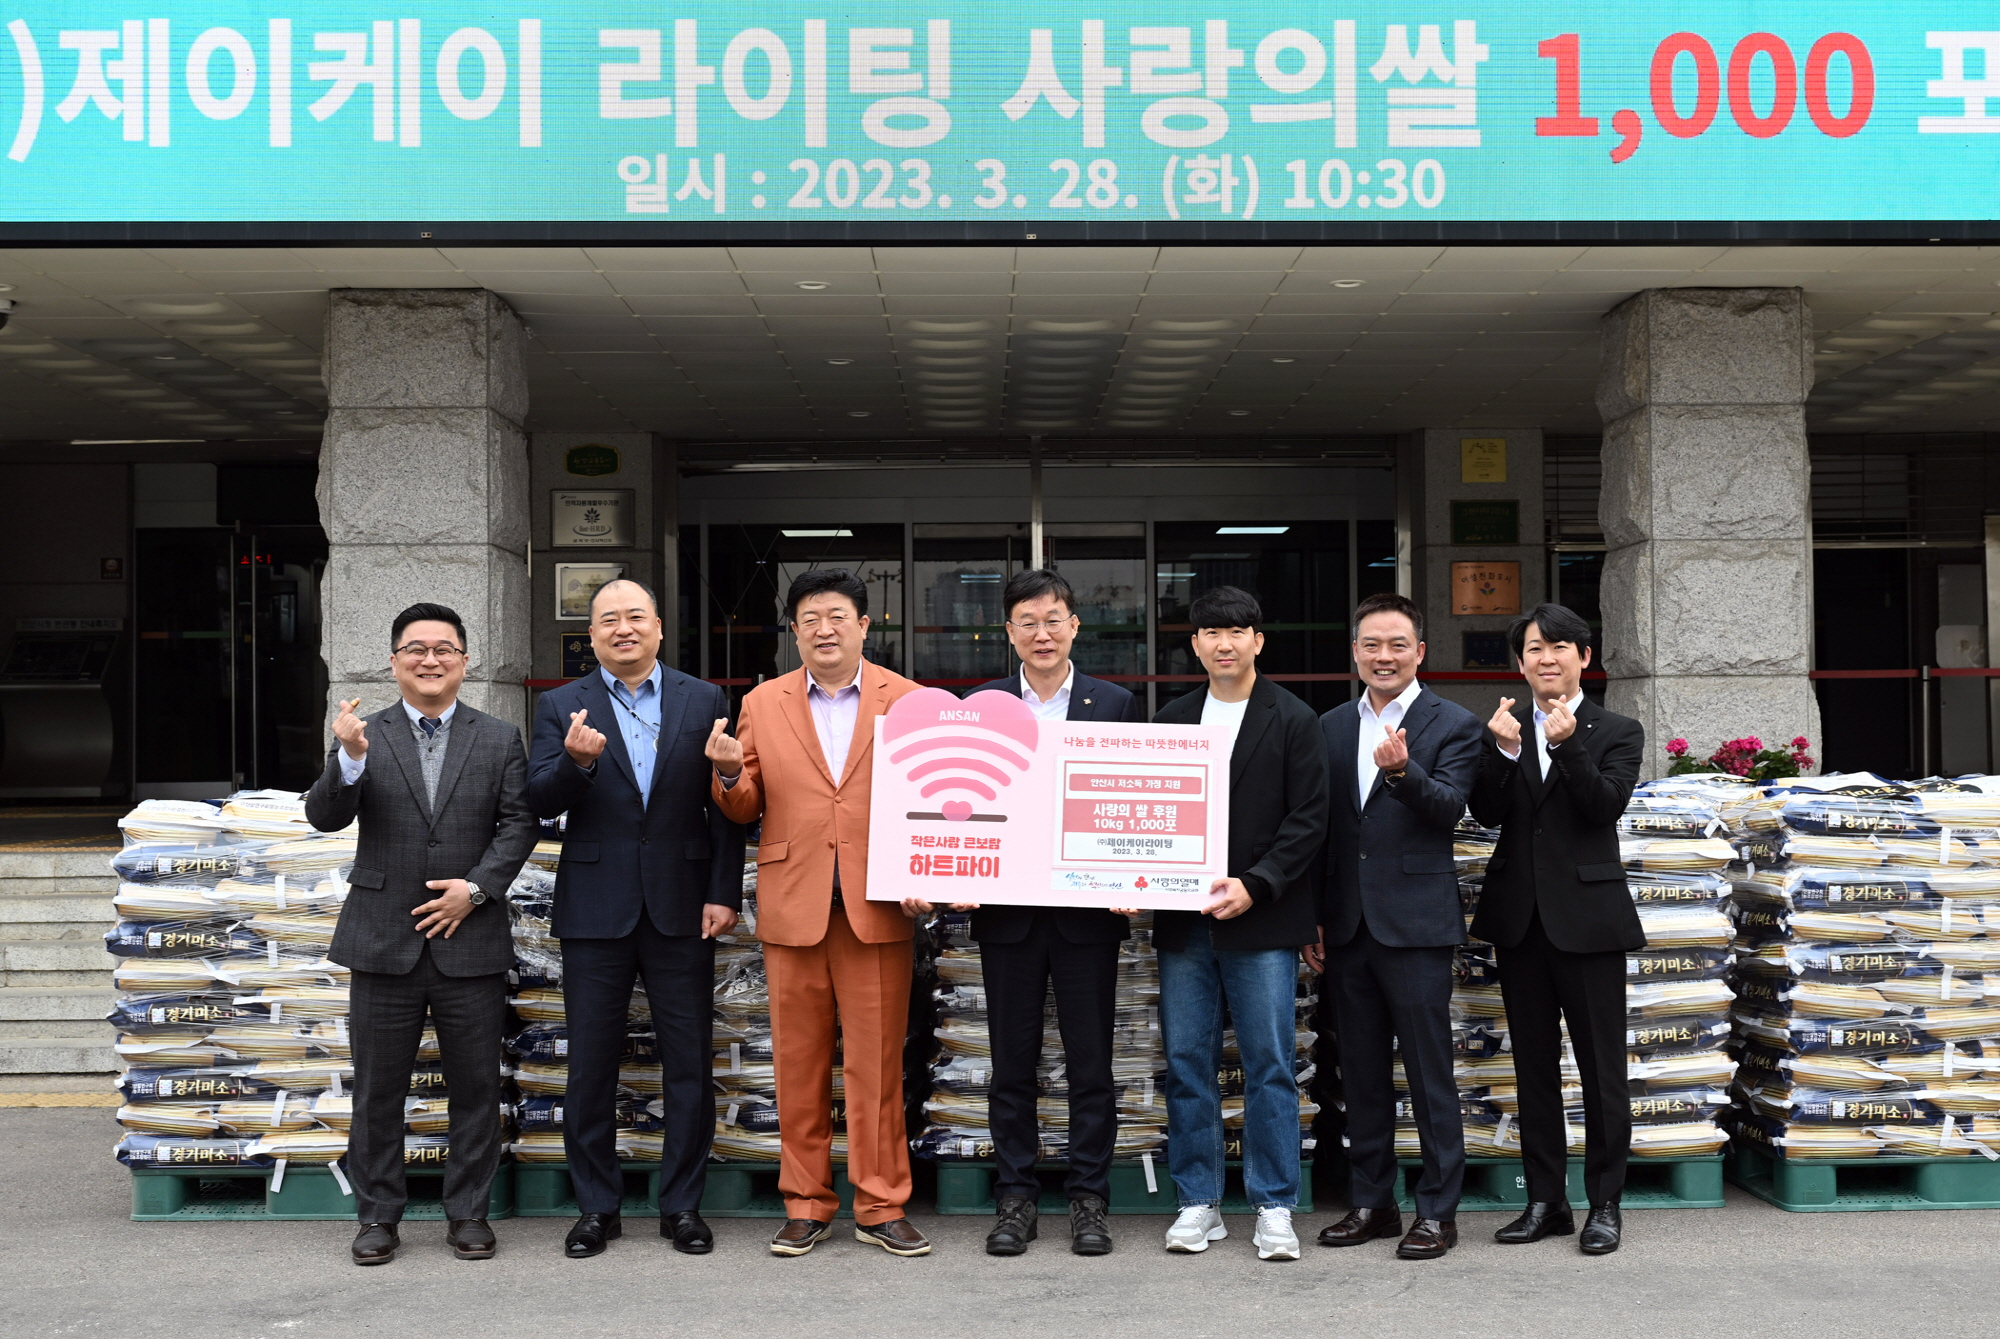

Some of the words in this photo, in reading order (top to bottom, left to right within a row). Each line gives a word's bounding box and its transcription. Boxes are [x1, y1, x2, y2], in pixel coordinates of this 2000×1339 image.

[599, 19, 953, 149] 라이팅
[1003, 19, 1491, 149] 사랑의쌀
[1535, 32, 1874, 164] 1,000
[617, 154, 728, 214] 일시
[787, 158, 952, 210] 2023.
[974, 158, 1026, 210] 3.
[1048, 158, 1138, 210] 28.
[1162, 153, 1259, 220] (화)
[1285, 158, 1446, 210] 10:30
[938, 710, 980, 722] ANSAN
[1064, 736, 1096, 748] 나눔을
[1099, 737, 1142, 749] 전파하는
[1090, 778, 1115, 788] 안산시
[1118, 779, 1143, 789] 저소득
[1145, 779, 1162, 789] 가정
[1164, 780, 1181, 790] 지원
[1093, 803, 1130, 817] 사랑의
[1135, 804, 1148, 818] 쌀
[1153, 804, 1177, 819] 후원
[1093, 818, 1124, 831] 10kg
[1129, 819, 1177, 832] 1,000포
[911, 835, 960, 848] 작은사랑
[964, 837, 1001, 850] 큰보람
[1112, 848, 1133, 856] 2023.
[1135, 848, 1143, 856] 3.
[1145, 848, 1157, 857] 28.
[173, 857, 231, 873] 경기미소
[909, 853, 1000, 878] 하트파이
[1150, 877, 1199, 888] 사랑의열매
[1639, 886, 1695, 900] 경기미소
[1842, 885, 1897, 901] 경기미소
[162, 932, 219, 948] 경기미소
[1640, 955, 1696, 974] 경기미소
[1842, 951, 1897, 971] 경기미소
[165, 1006, 223, 1022] 경기미소
[1636, 1027, 1693, 1044] 경기미소
[1844, 1030, 1900, 1046] 경기미소
[174, 1079, 229, 1095] 경기미소
[1846, 1102, 1902, 1119] 경기미소
[171, 1147, 227, 1162] 경기미소
